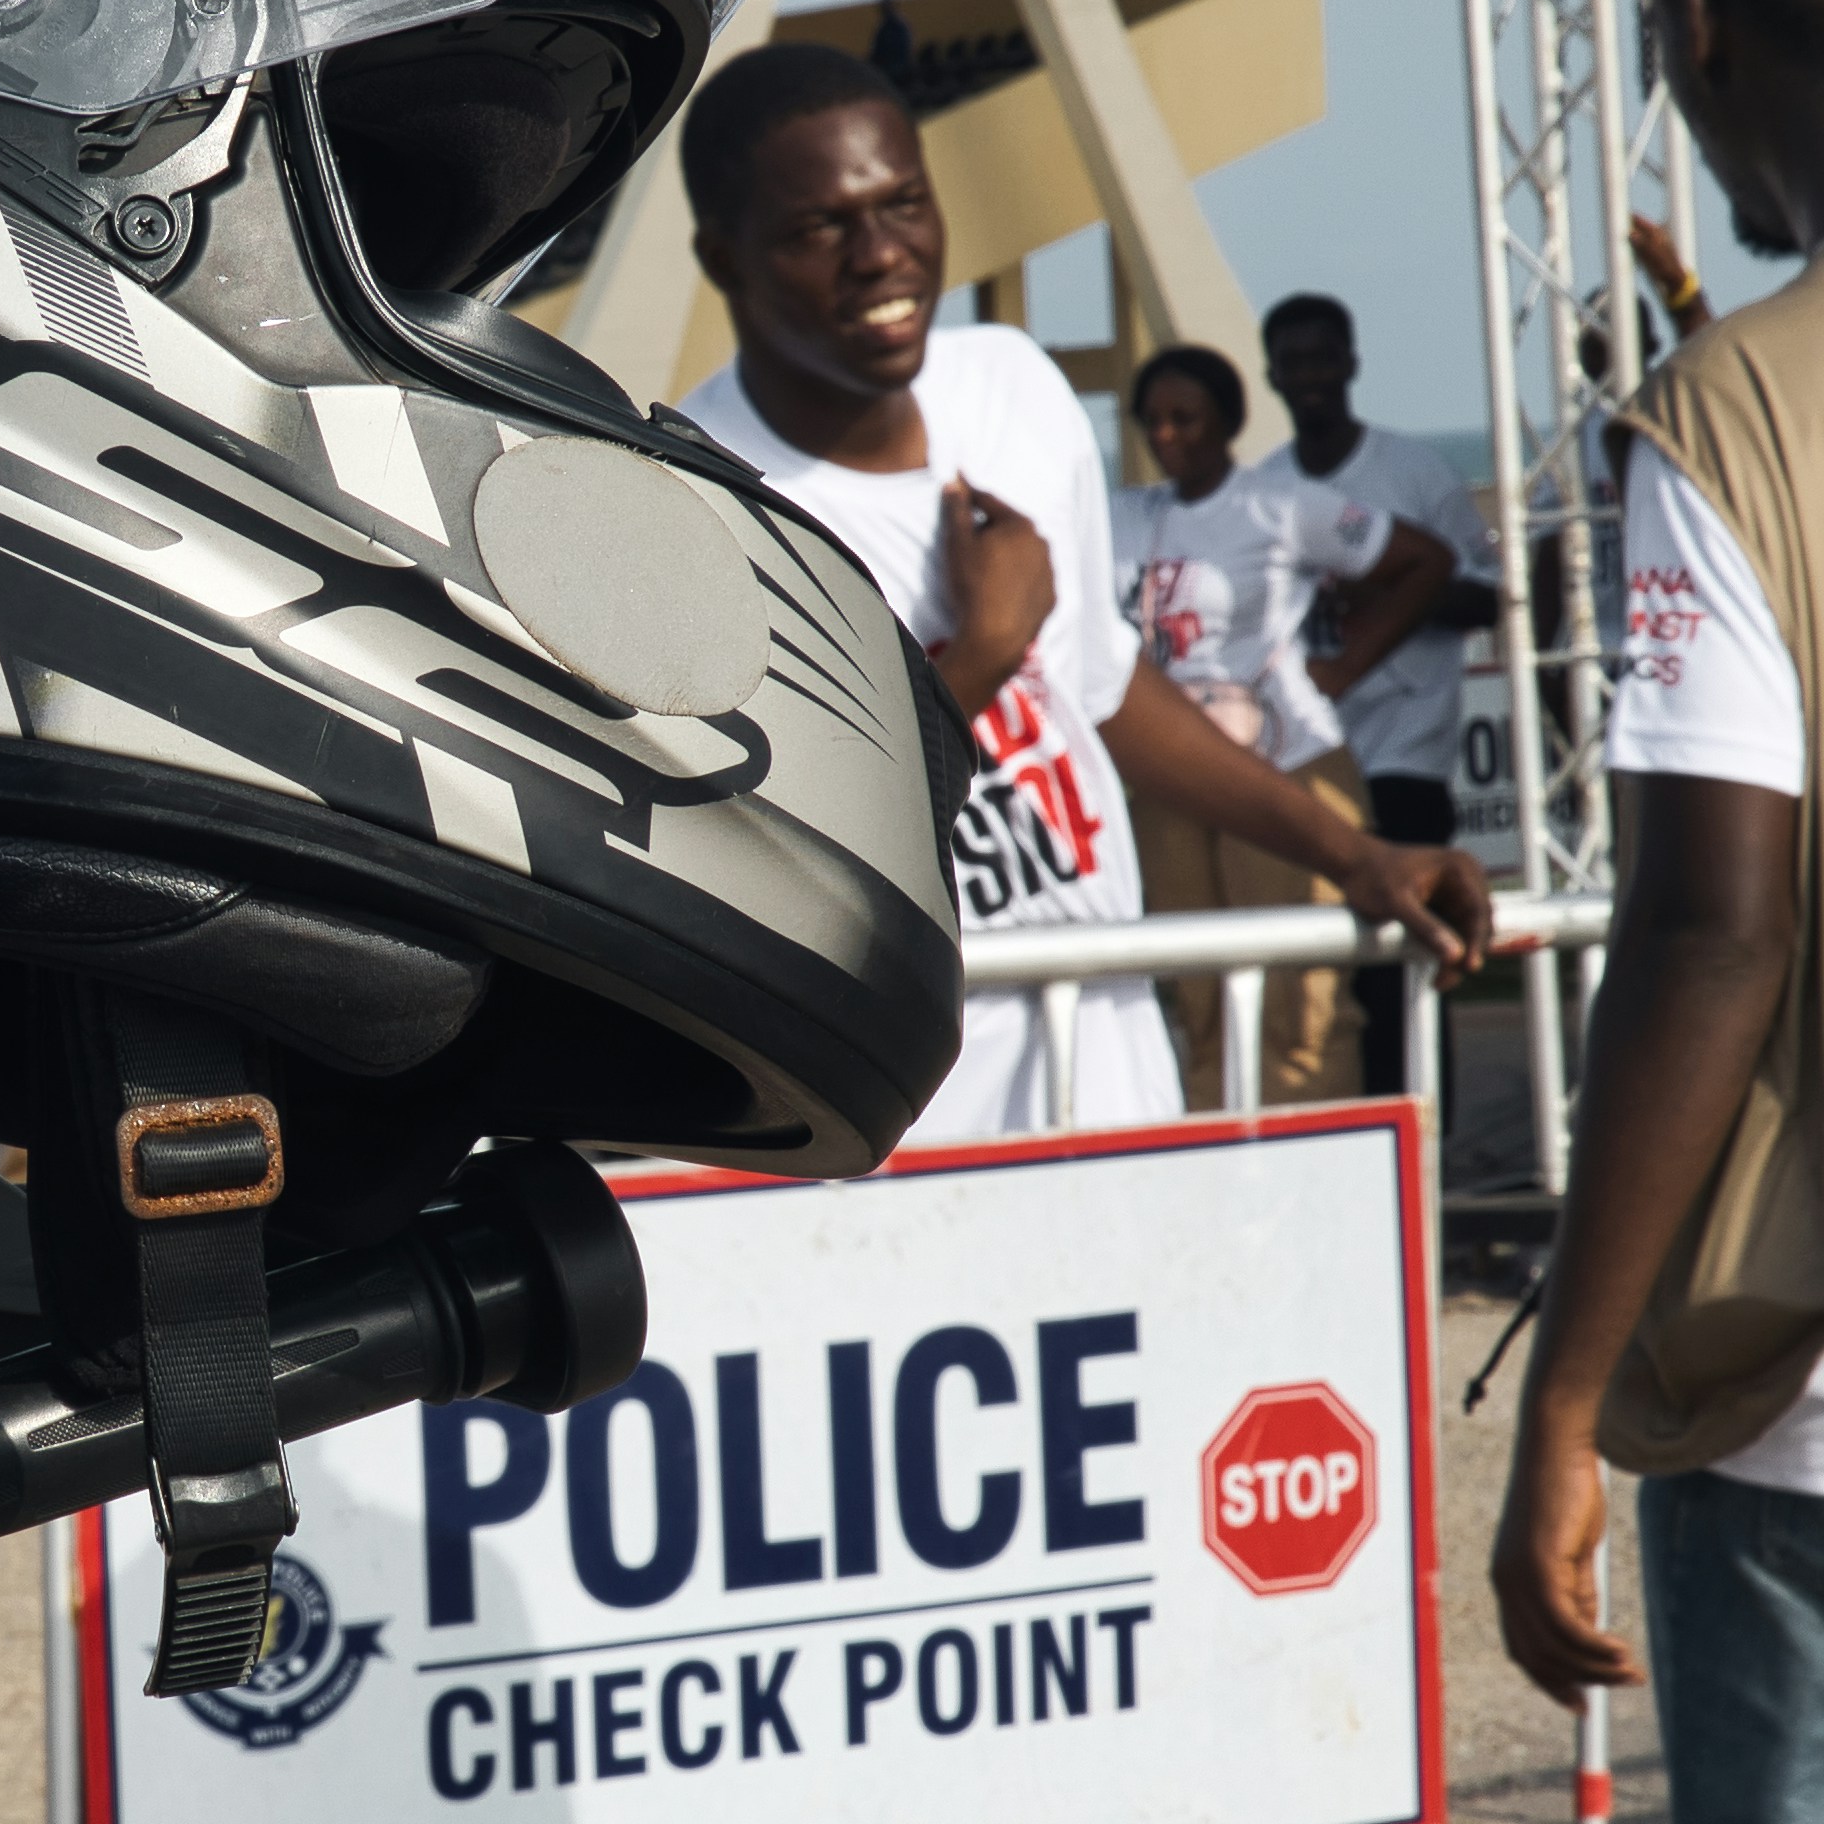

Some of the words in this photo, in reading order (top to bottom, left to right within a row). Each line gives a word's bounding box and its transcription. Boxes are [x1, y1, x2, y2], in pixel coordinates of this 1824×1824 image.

[420, 1310, 1146, 1629] POLICE
[1222, 1451, 1359, 1528] STOP
[428, 1647, 801, 1801] CHECK
[844, 1605, 1154, 1746] POINT
